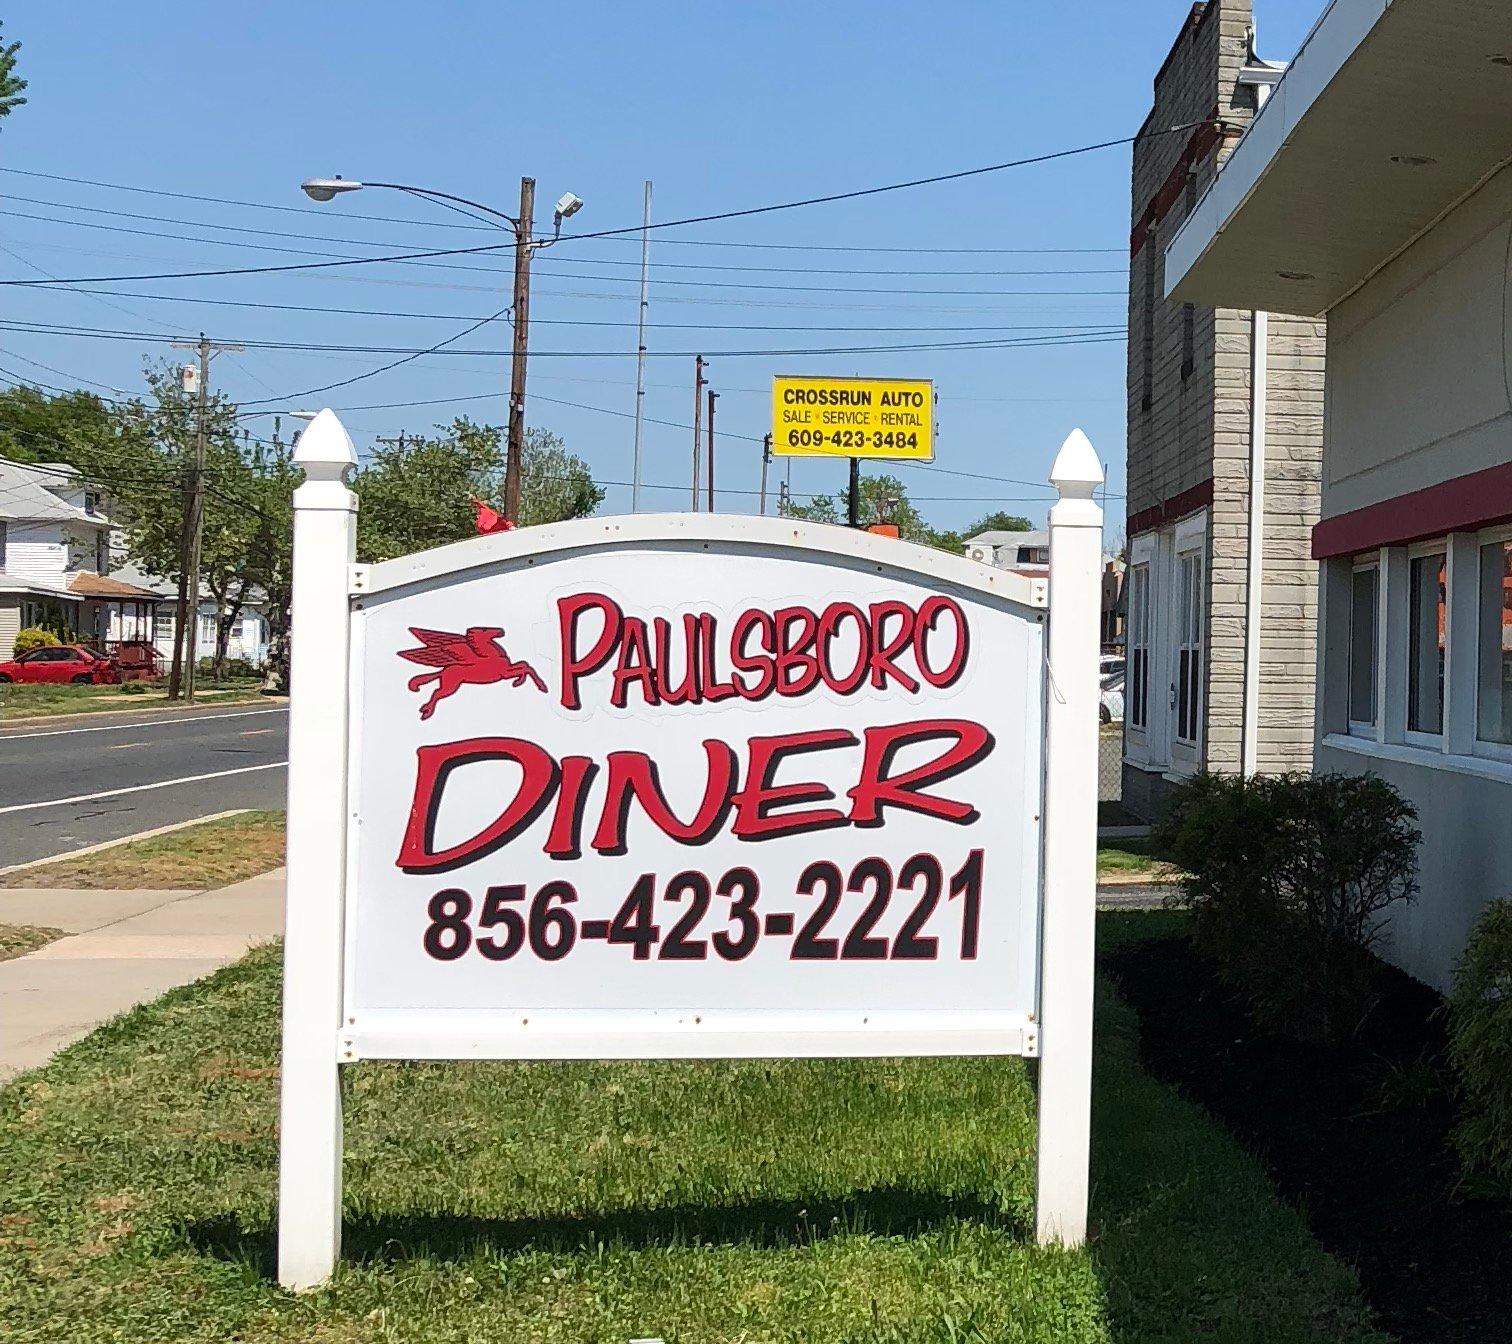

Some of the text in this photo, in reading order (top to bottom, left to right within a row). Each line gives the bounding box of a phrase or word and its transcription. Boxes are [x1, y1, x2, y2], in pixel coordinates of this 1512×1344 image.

[782, 409, 923, 427] SALE SERVICE RENTAL
[783, 388, 924, 407] CROSSRUN AUTO
[788, 429, 918, 449] 609-423-3484
[556, 591, 971, 711] PAULSBORO
[395, 718, 997, 875] DINER
[423, 847, 986, 962] 856-423-2221
